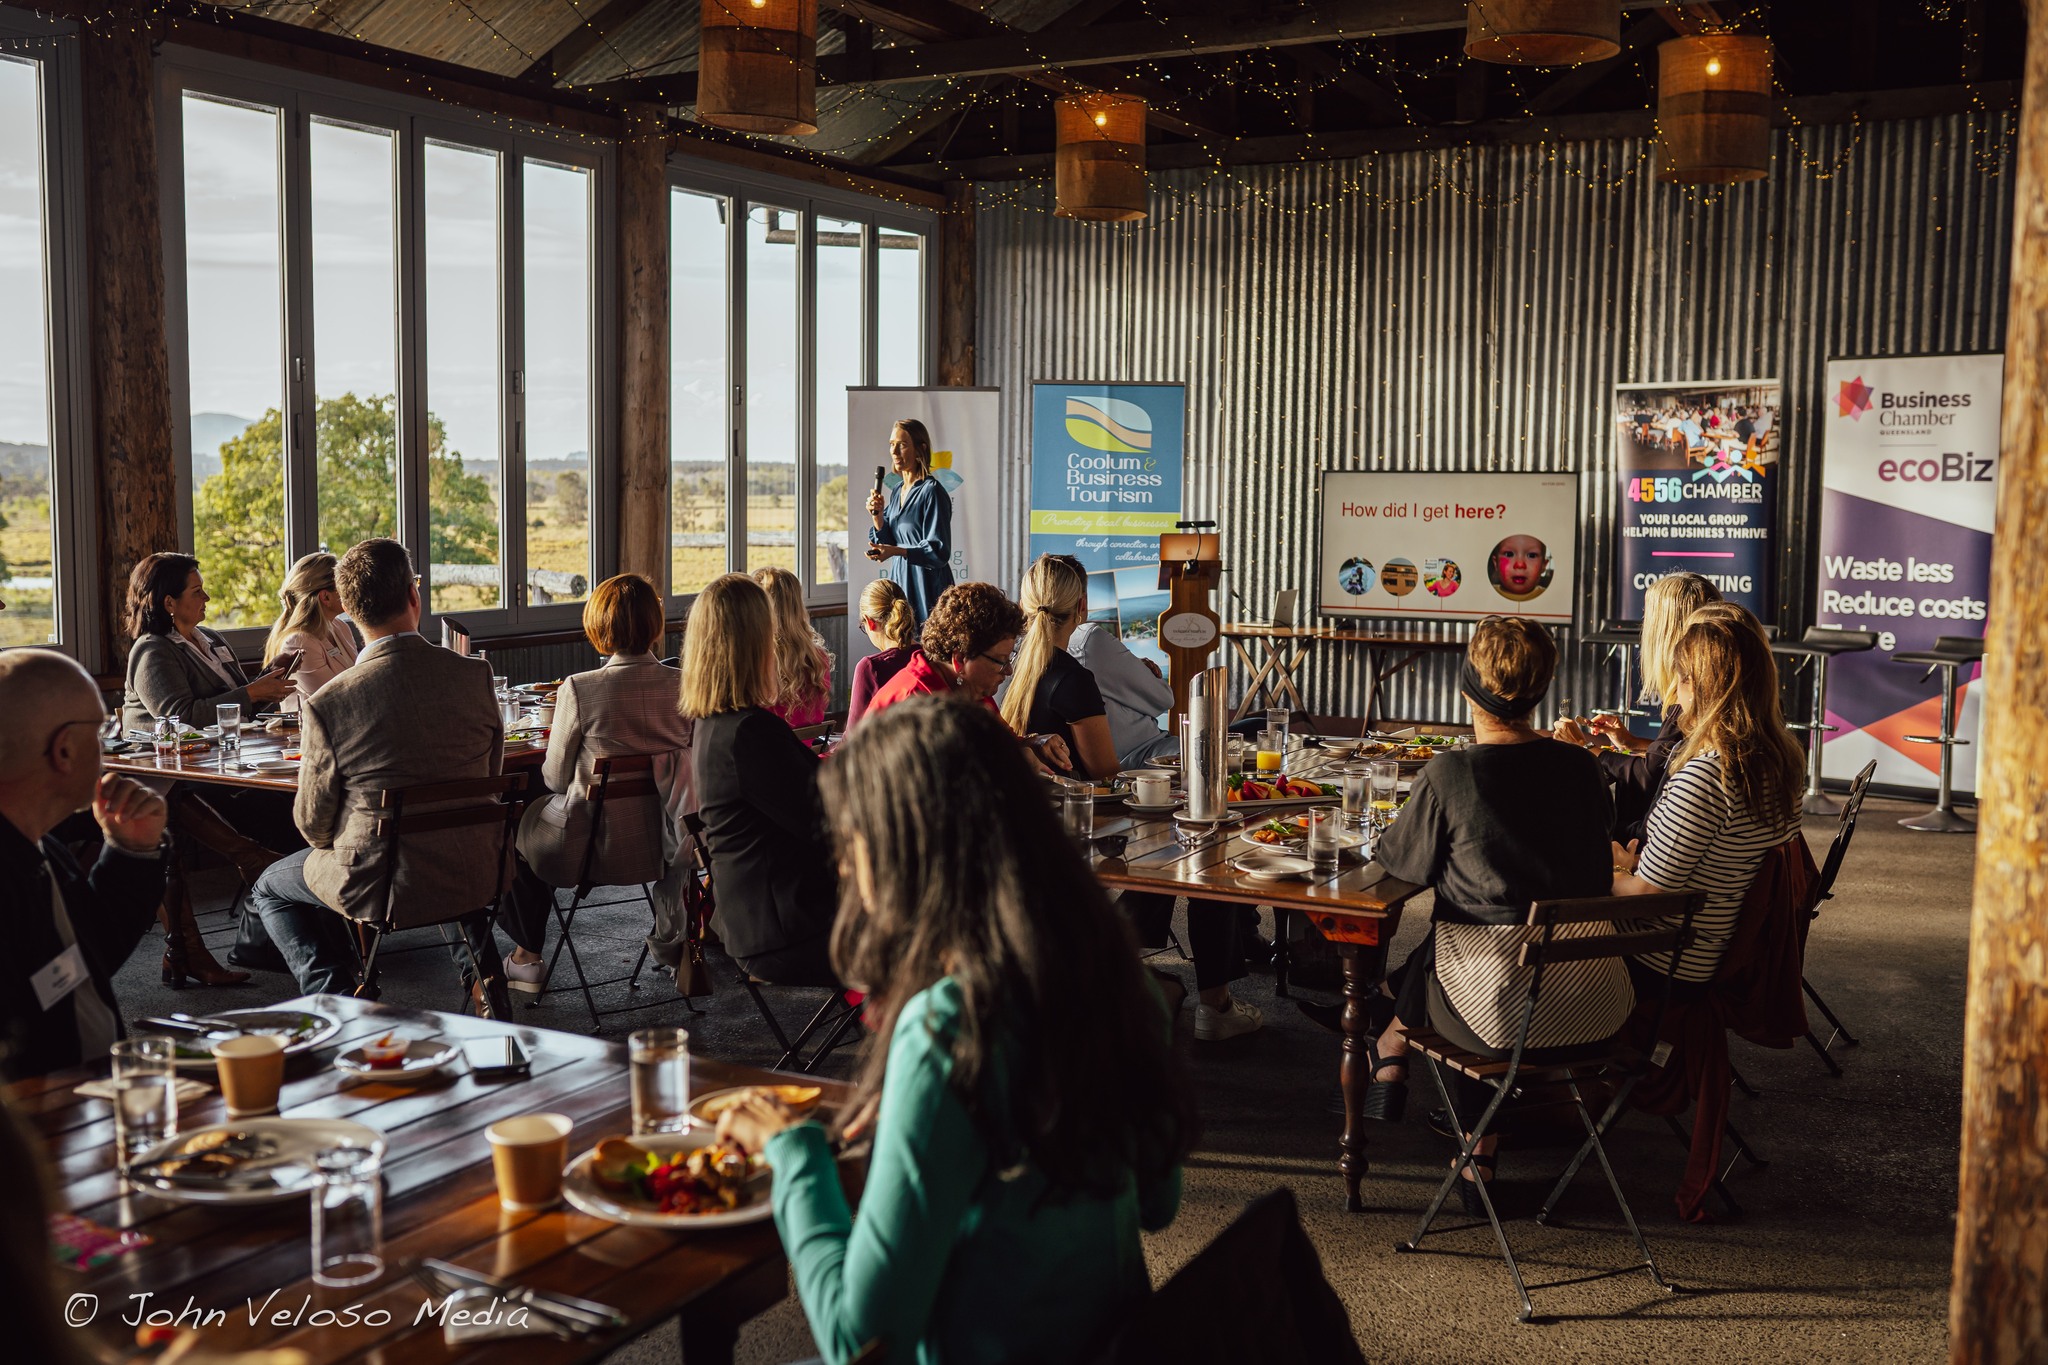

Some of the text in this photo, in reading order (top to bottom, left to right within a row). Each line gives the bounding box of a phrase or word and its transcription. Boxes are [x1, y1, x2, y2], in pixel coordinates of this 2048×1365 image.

[1881, 391, 1972, 409] Business
[1879, 410, 1957, 427] Chamber
[1067, 453, 1157, 472] Coolum &
[1878, 451, 1994, 483] ecoBiz
[1066, 469, 1163, 487] Business
[1066, 486, 1153, 504] Tourism
[1627, 477, 1763, 503] 4556 CHAMBER
[1342, 502, 1506, 522] How did I get here?
[1639, 514, 1748, 526] YOUR LOCAL GROUP
[1041, 513, 1169, 532] Promoting local businesses
[1623, 527, 1768, 539] HELPING BUSINESS THRIVE
[1075, 537, 1109, 552] through
[1109, 539, 1149, 549] connection
[1824, 555, 1955, 583] Waste less
[1823, 589, 1987, 621] Reduce costs
